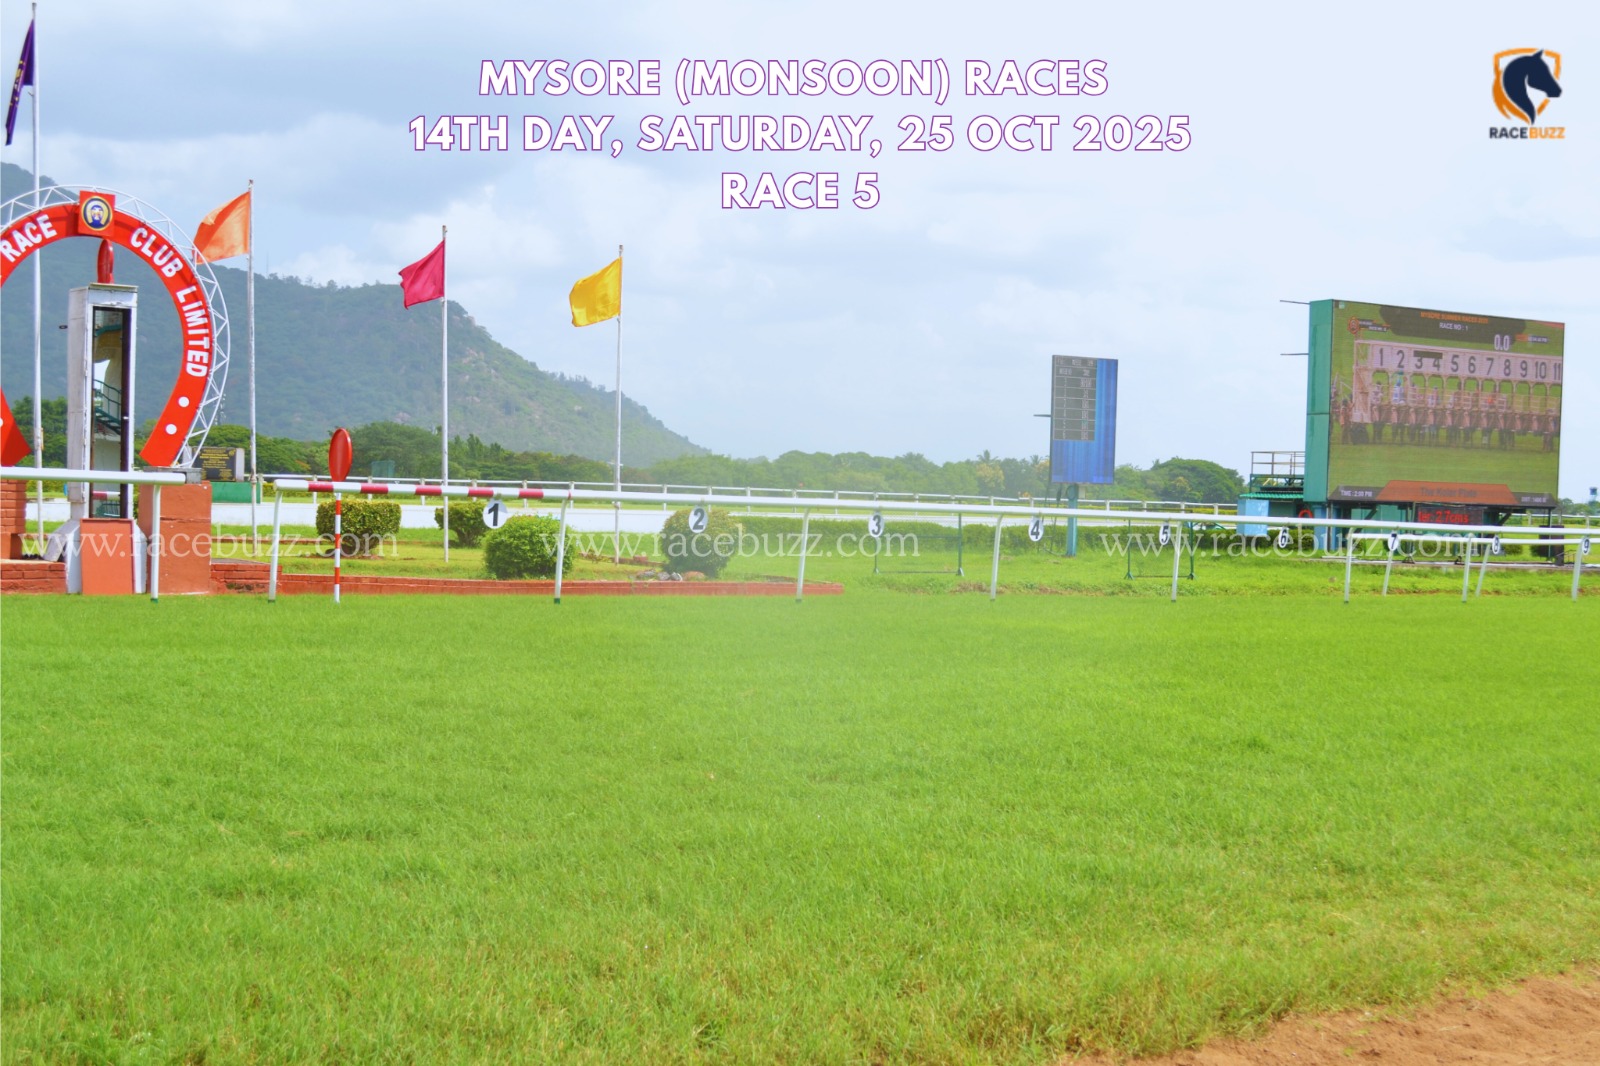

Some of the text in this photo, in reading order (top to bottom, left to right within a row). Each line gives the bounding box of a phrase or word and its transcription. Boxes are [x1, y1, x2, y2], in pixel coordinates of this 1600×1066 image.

[0, 214, 210, 378] RACE CLUB LIMITED
[1379, 347, 1384, 366] 1
[1396, 349, 1405, 369] 2
[1414, 356, 1423, 370] 3
[1432, 357, 1441, 372] 4
[1450, 354, 1460, 372] 5
[1467, 355, 1477, 374] 6
[1486, 357, 1495, 376] 7
[1503, 358, 1512, 377] 8
[1520, 359, 1529, 378] 9
[1534, 360, 1547, 379] 10
[487, 503, 499, 526] 1
[692, 508, 705, 530] 2
[871, 514, 881, 535] 3
[1030, 519, 1040, 539] 4
[1161, 524, 1169, 543] 5
[1280, 528, 1287, 547] 6
[1390, 533, 1397, 549] 7
[1493, 535, 1499, 552] 8
[1582, 538, 1590, 554] 9
